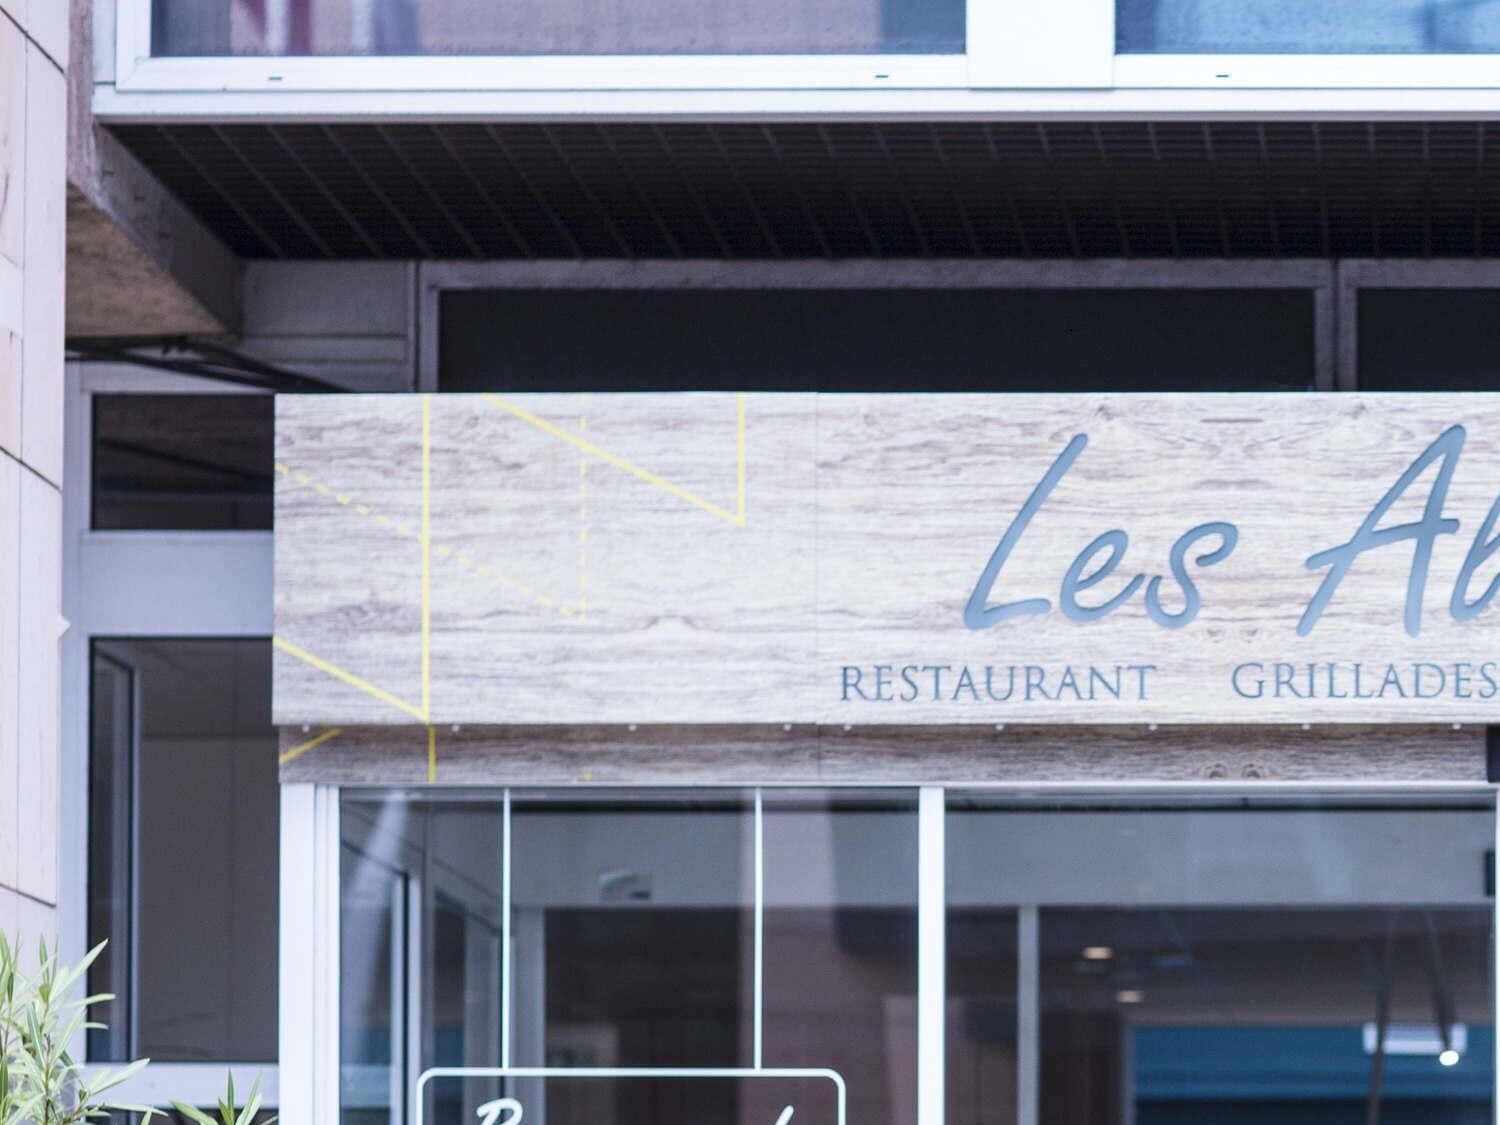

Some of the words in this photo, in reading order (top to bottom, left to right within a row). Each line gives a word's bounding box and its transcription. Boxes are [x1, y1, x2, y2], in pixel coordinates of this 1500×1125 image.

[963, 431, 1239, 630] Les
[840, 665, 1156, 701] RESTAURANT
[1231, 662, 1499, 700] GRILLADES
